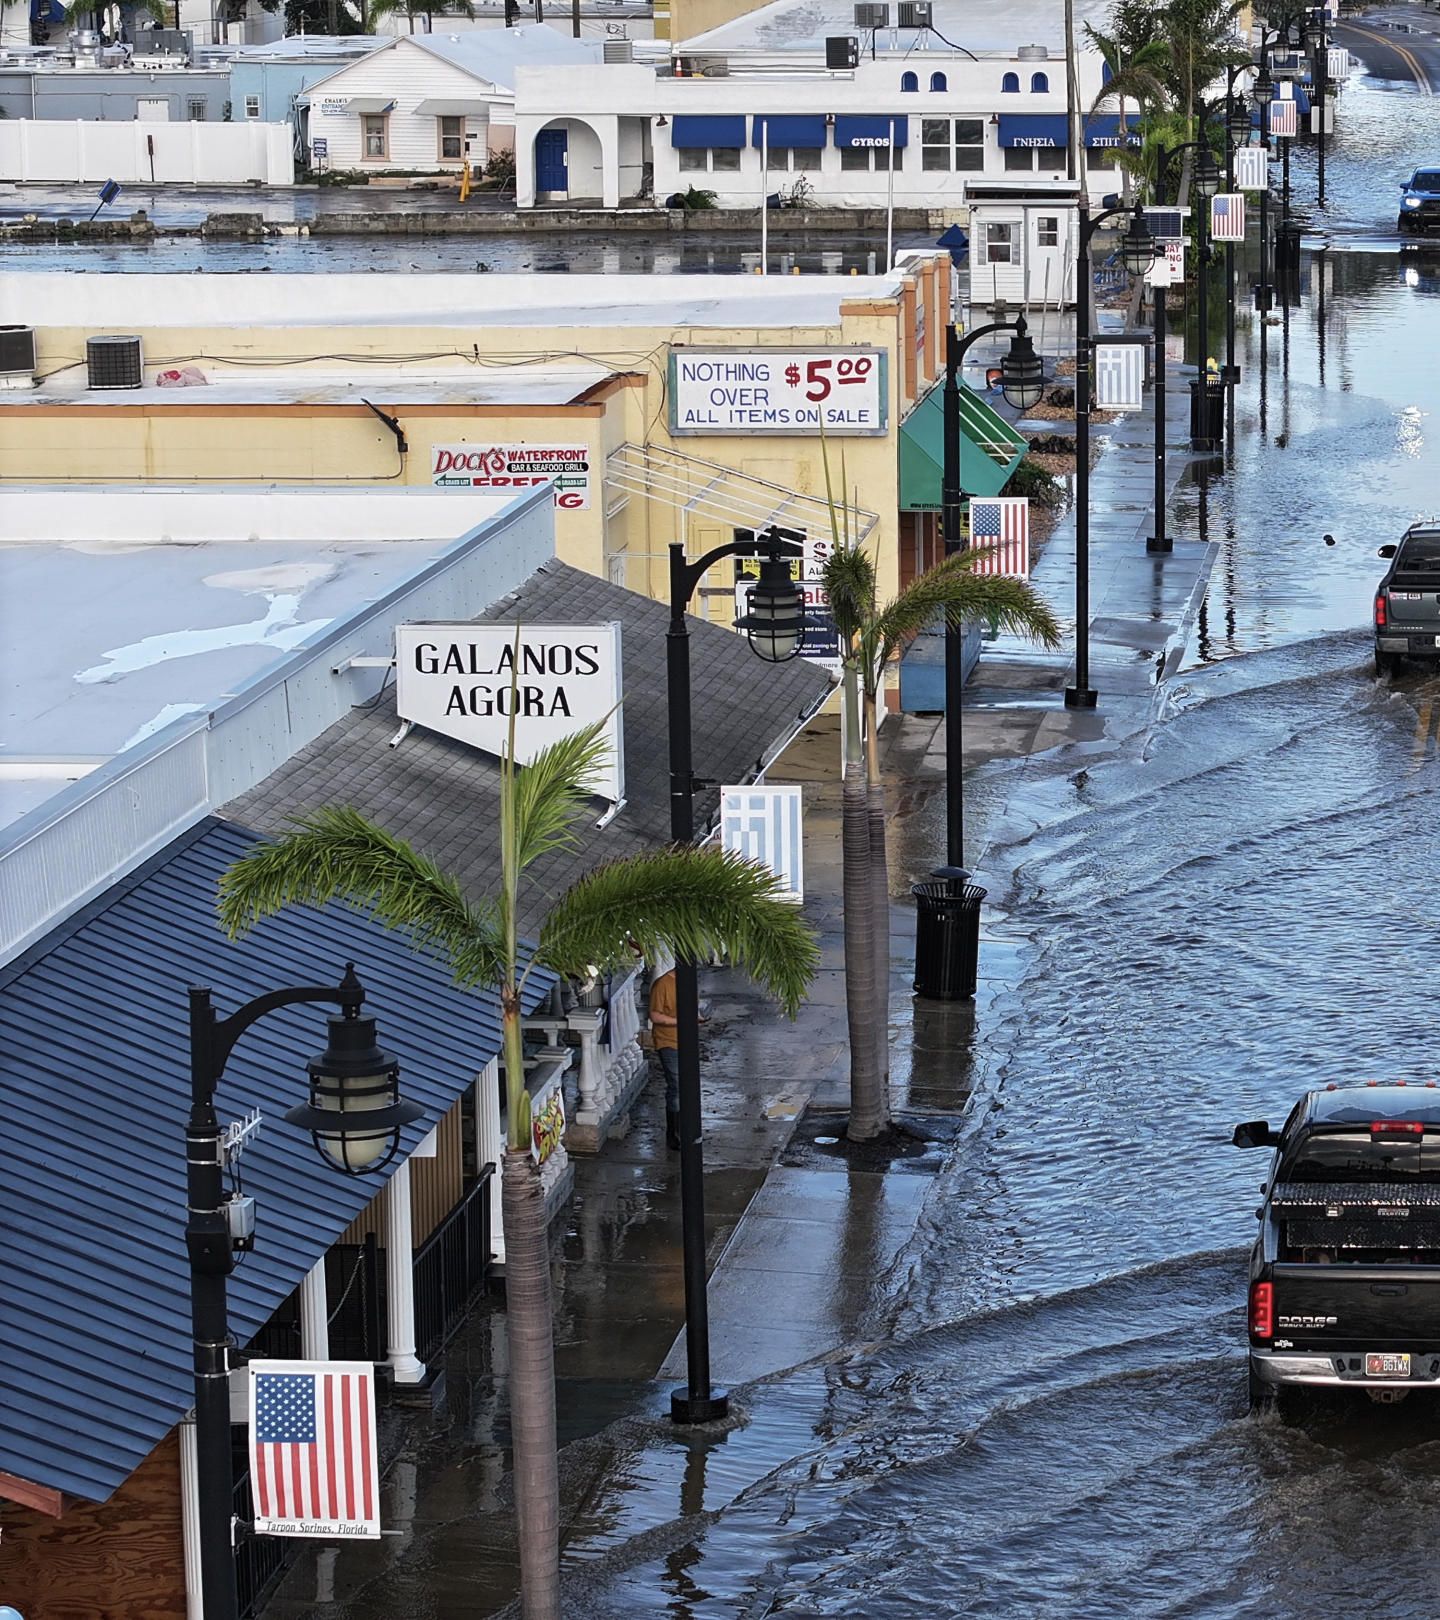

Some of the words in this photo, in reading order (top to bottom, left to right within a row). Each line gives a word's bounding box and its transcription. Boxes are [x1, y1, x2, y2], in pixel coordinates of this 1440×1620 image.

[852, 137, 890, 147] GYROS
[682, 362, 770, 382] NOTHING
[710, 388, 769, 406] OVER
[685, 409, 719, 423] ALL
[729, 409, 790, 423] ITEMS
[795, 409, 819, 423] ON
[827, 409, 870, 423] SALE
[507, 450, 587, 462] WATERFRONT
[511, 463, 525, 472] BAR
[526, 463, 531, 471] &
[532, 462, 563, 472] SEAFOOD
[564, 462, 584, 472] GRILL
[415, 643, 600, 676] GALANOS
[443, 685, 575, 717] AGORA
[1278, 1316, 1338, 1324] DODGE
[267, 1521, 296, 1532] Tarpon
[338, 1523, 368, 1535] Florida
